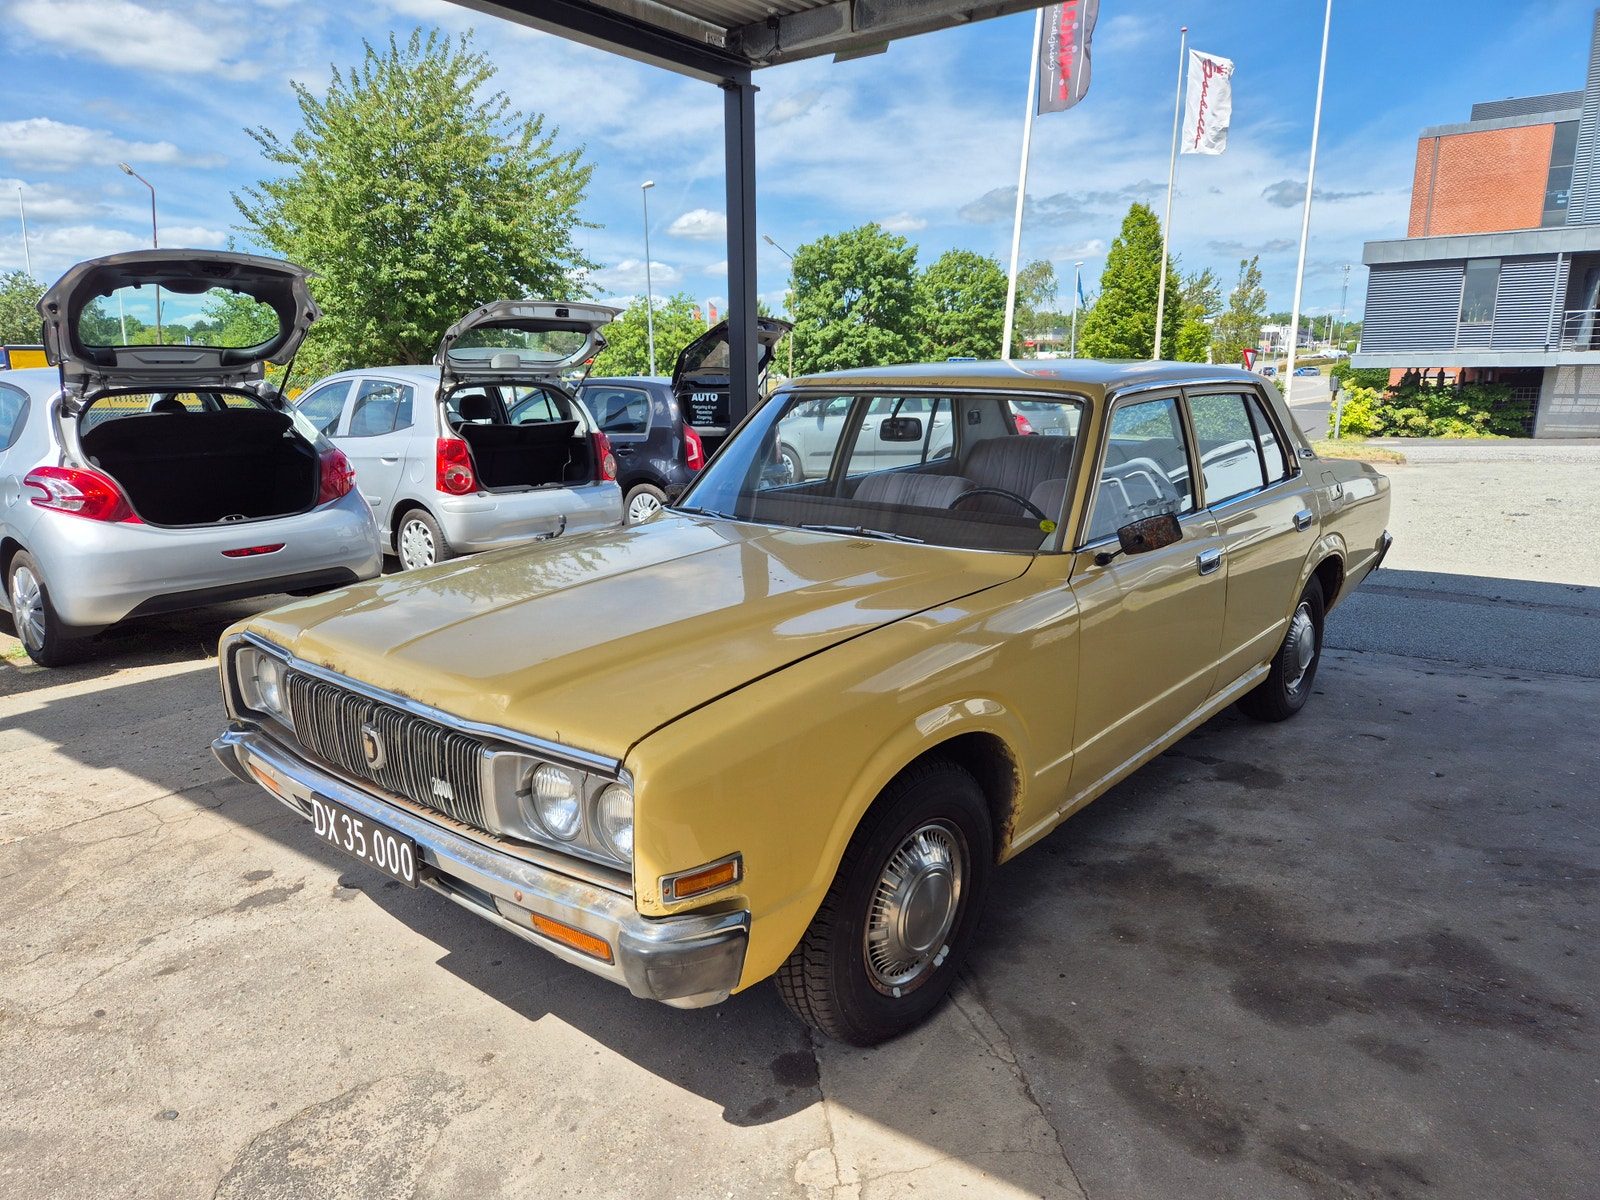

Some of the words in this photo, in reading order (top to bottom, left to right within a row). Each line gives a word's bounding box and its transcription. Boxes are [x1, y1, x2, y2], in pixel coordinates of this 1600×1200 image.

[691, 393, 718, 402] AUTO
[311, 799, 340, 845] DX
[342, 815, 413, 881] 35.000
